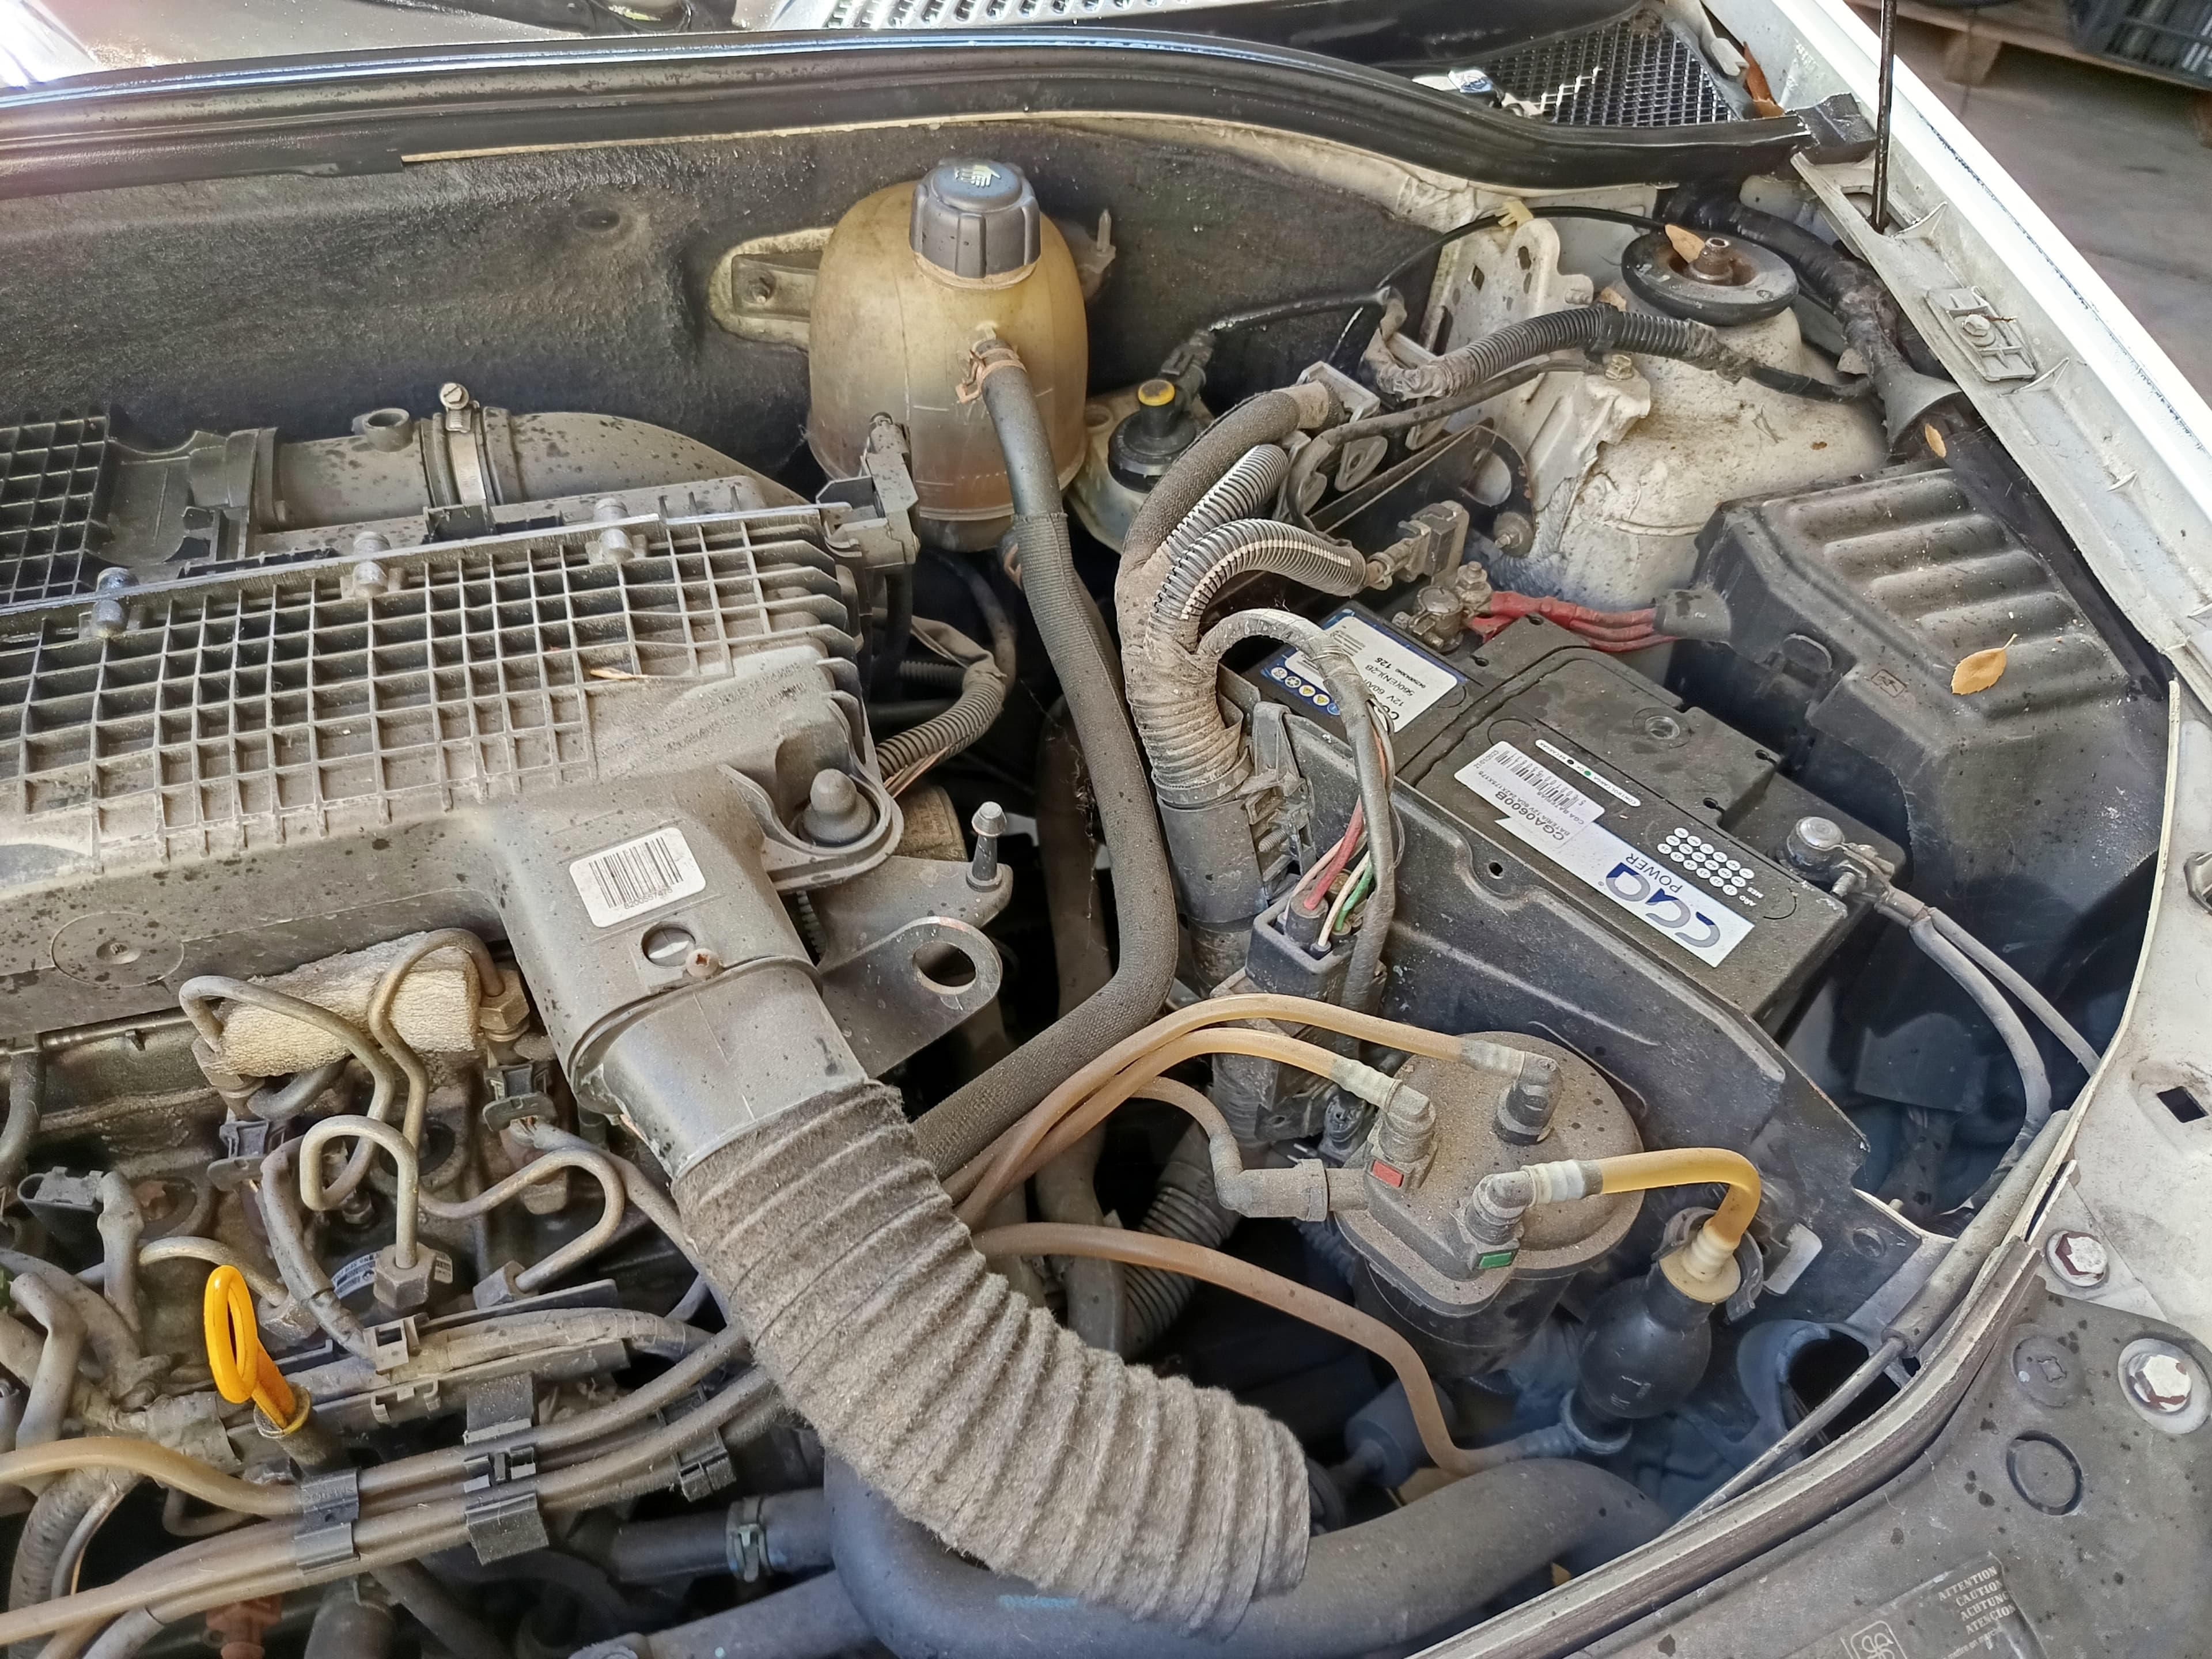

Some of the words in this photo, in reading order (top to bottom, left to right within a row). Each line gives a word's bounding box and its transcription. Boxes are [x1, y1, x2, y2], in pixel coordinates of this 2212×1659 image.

[1374, 657, 1392, 669] 125
[1387, 695, 1404, 707] 12V
[1495, 791, 1564, 840] CGA0600B
[1569, 813, 1584, 824] CGA
[1625, 853, 1683, 893] POWER
[1938, 1566, 1998, 1601] ATTENTION
[1955, 1580, 2003, 1607] CAUTION
